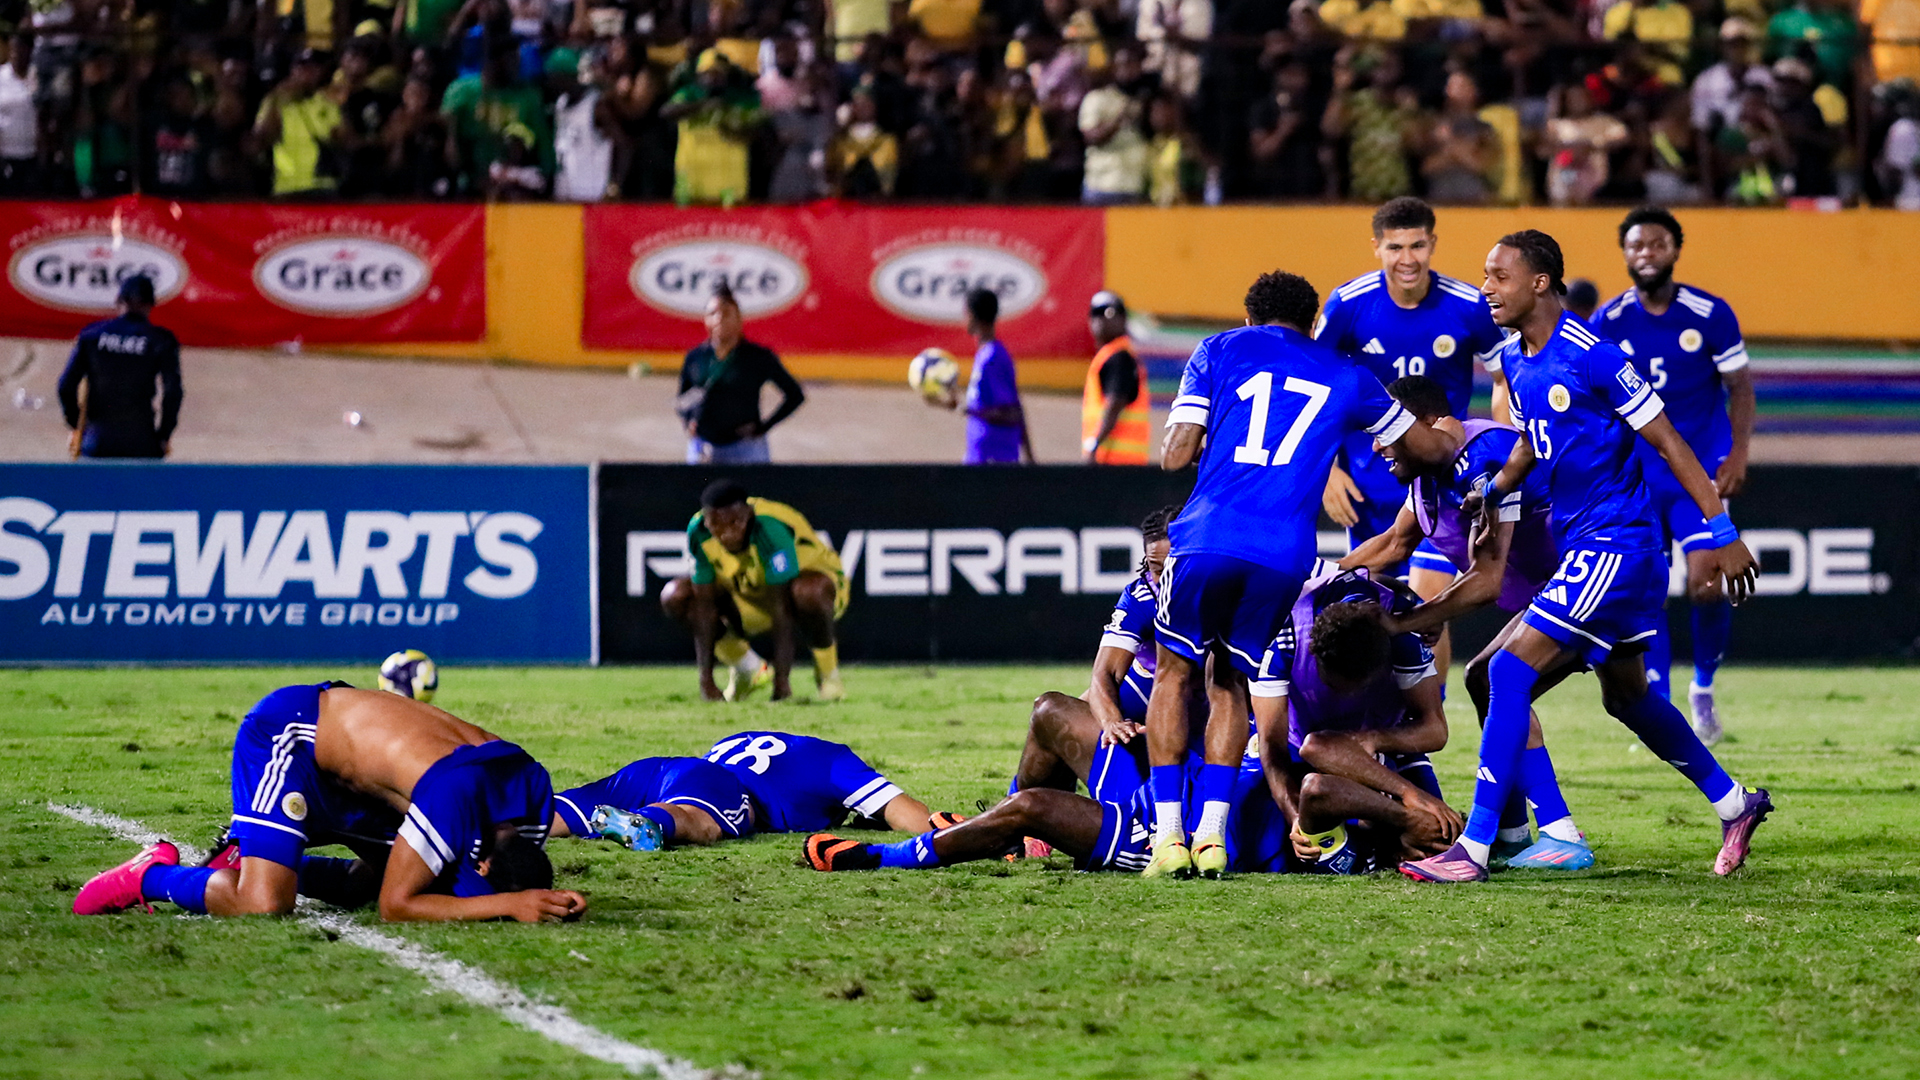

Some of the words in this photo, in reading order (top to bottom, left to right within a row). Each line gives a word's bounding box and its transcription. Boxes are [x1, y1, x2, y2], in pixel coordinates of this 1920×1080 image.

[279, 257, 403, 292] Grace
[656, 261, 779, 296] Grace
[97, 331, 148, 355] POLICE
[1649, 356, 1668, 390] 5
[1233, 371, 1332, 467] 17
[1527, 418, 1553, 460] 15
[0, 497, 543, 599] STEWART'S
[1552, 549, 1597, 584] 15
[41, 603, 306, 626] AUTOMOTIVE
[320, 603, 459, 626] GROUP
[707, 735, 787, 775] 18
